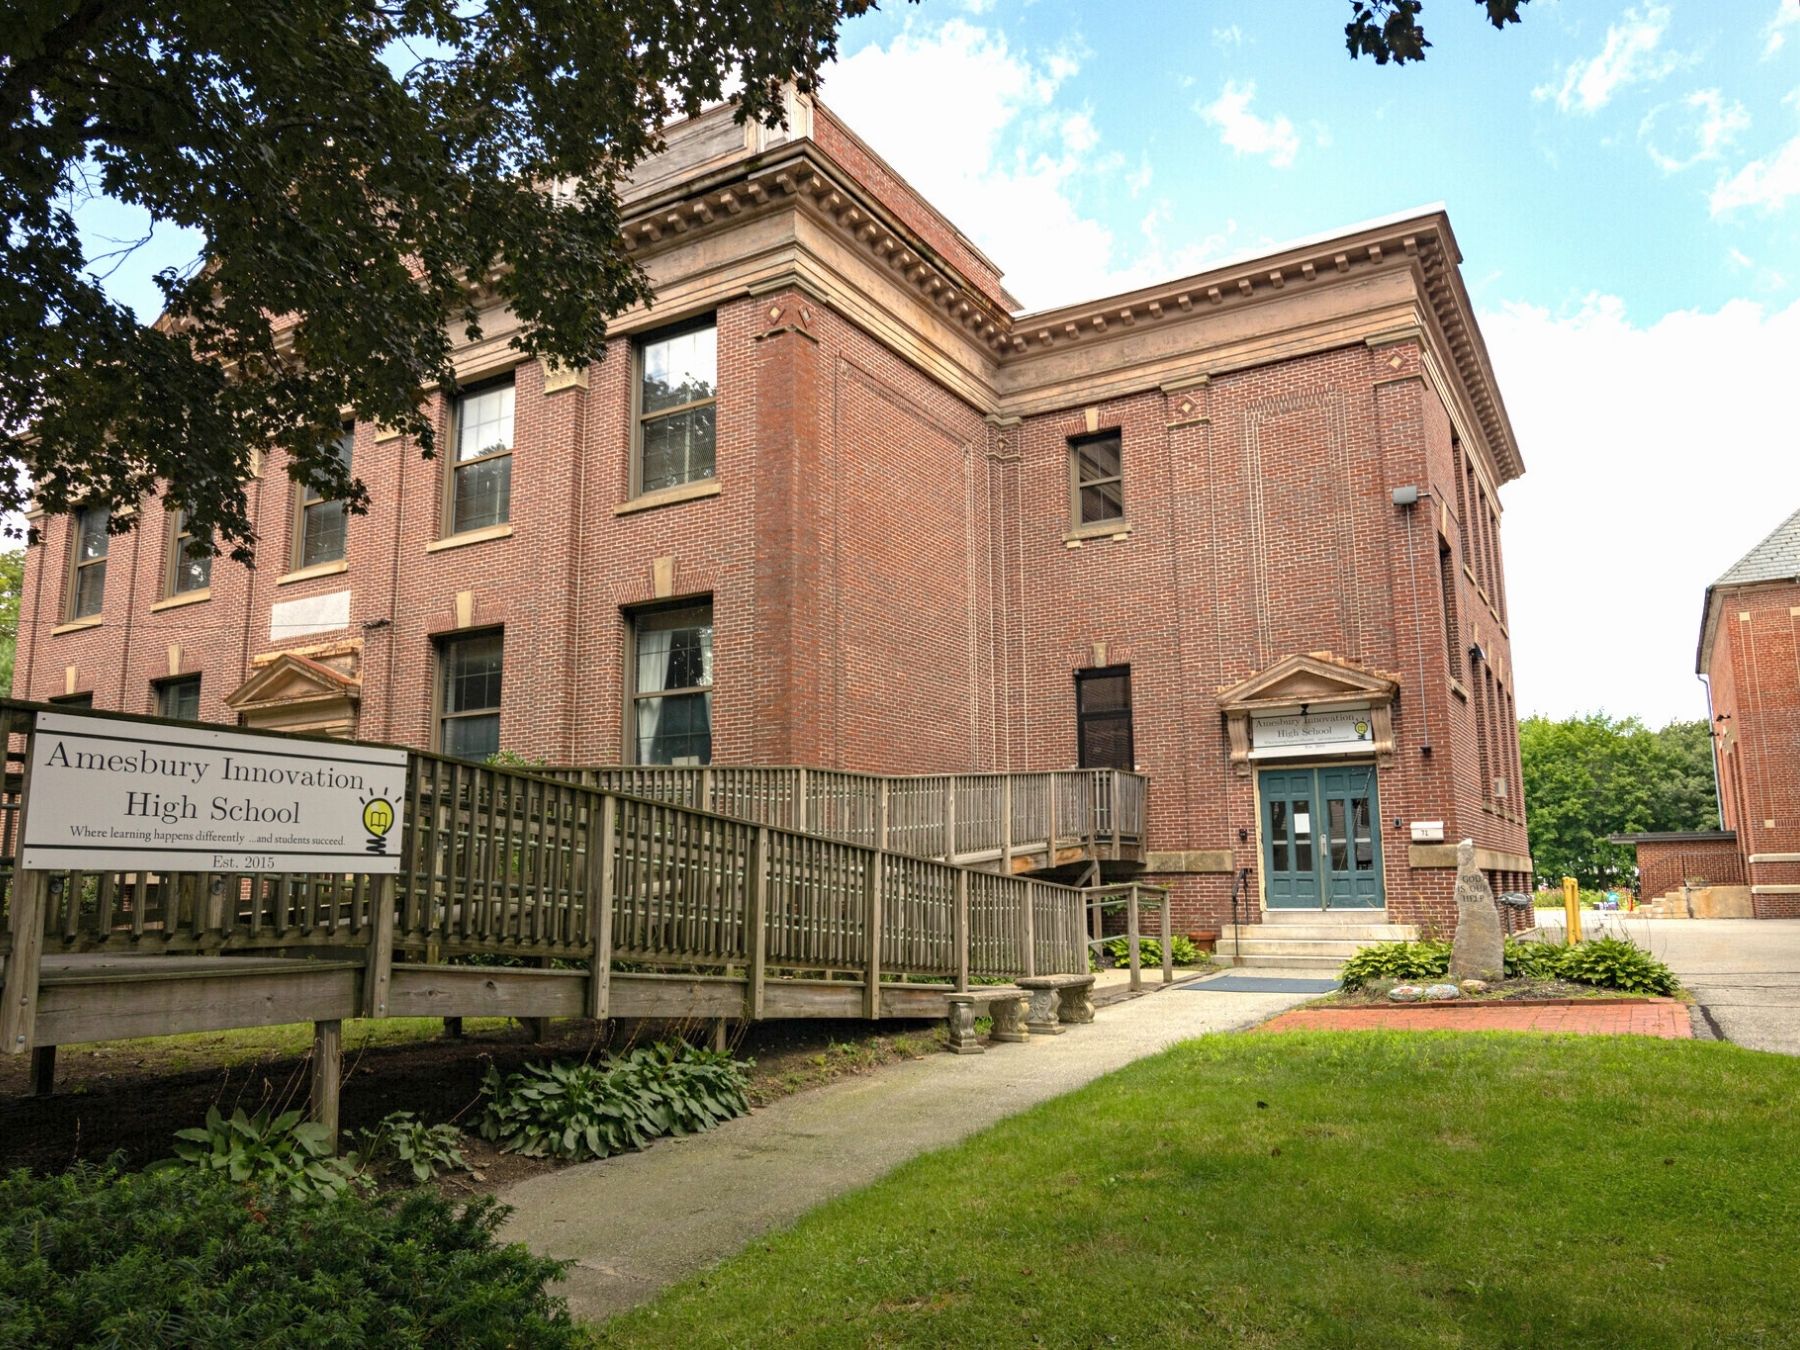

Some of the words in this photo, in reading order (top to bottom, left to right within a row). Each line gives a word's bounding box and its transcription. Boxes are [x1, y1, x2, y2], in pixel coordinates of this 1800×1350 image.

[1256, 718, 1299, 728] Amesbury
[1304, 714, 1354, 724] Innovation
[1277, 728, 1299, 738] High
[1302, 726, 1332, 736] School
[44, 740, 210, 783] Amesbury
[221, 756, 364, 790] Innovation
[123, 791, 198, 824] High
[210, 796, 301, 824] School
[70, 825, 107, 838] Where
[110, 826, 151, 842] learning
[154, 828, 193, 843] happens
[195, 830, 245, 845] differently
[274, 834, 310, 844] students
[312, 836, 346, 846] succeed.
[213, 855, 239, 869] Est.
[245, 855, 275, 869] 2015
[1462, 875, 1482, 883] GOD
[1457, 885, 1465, 893] IS
[1470, 884, 1488, 892] OUR
[1462, 895, 1485, 903] HELP
